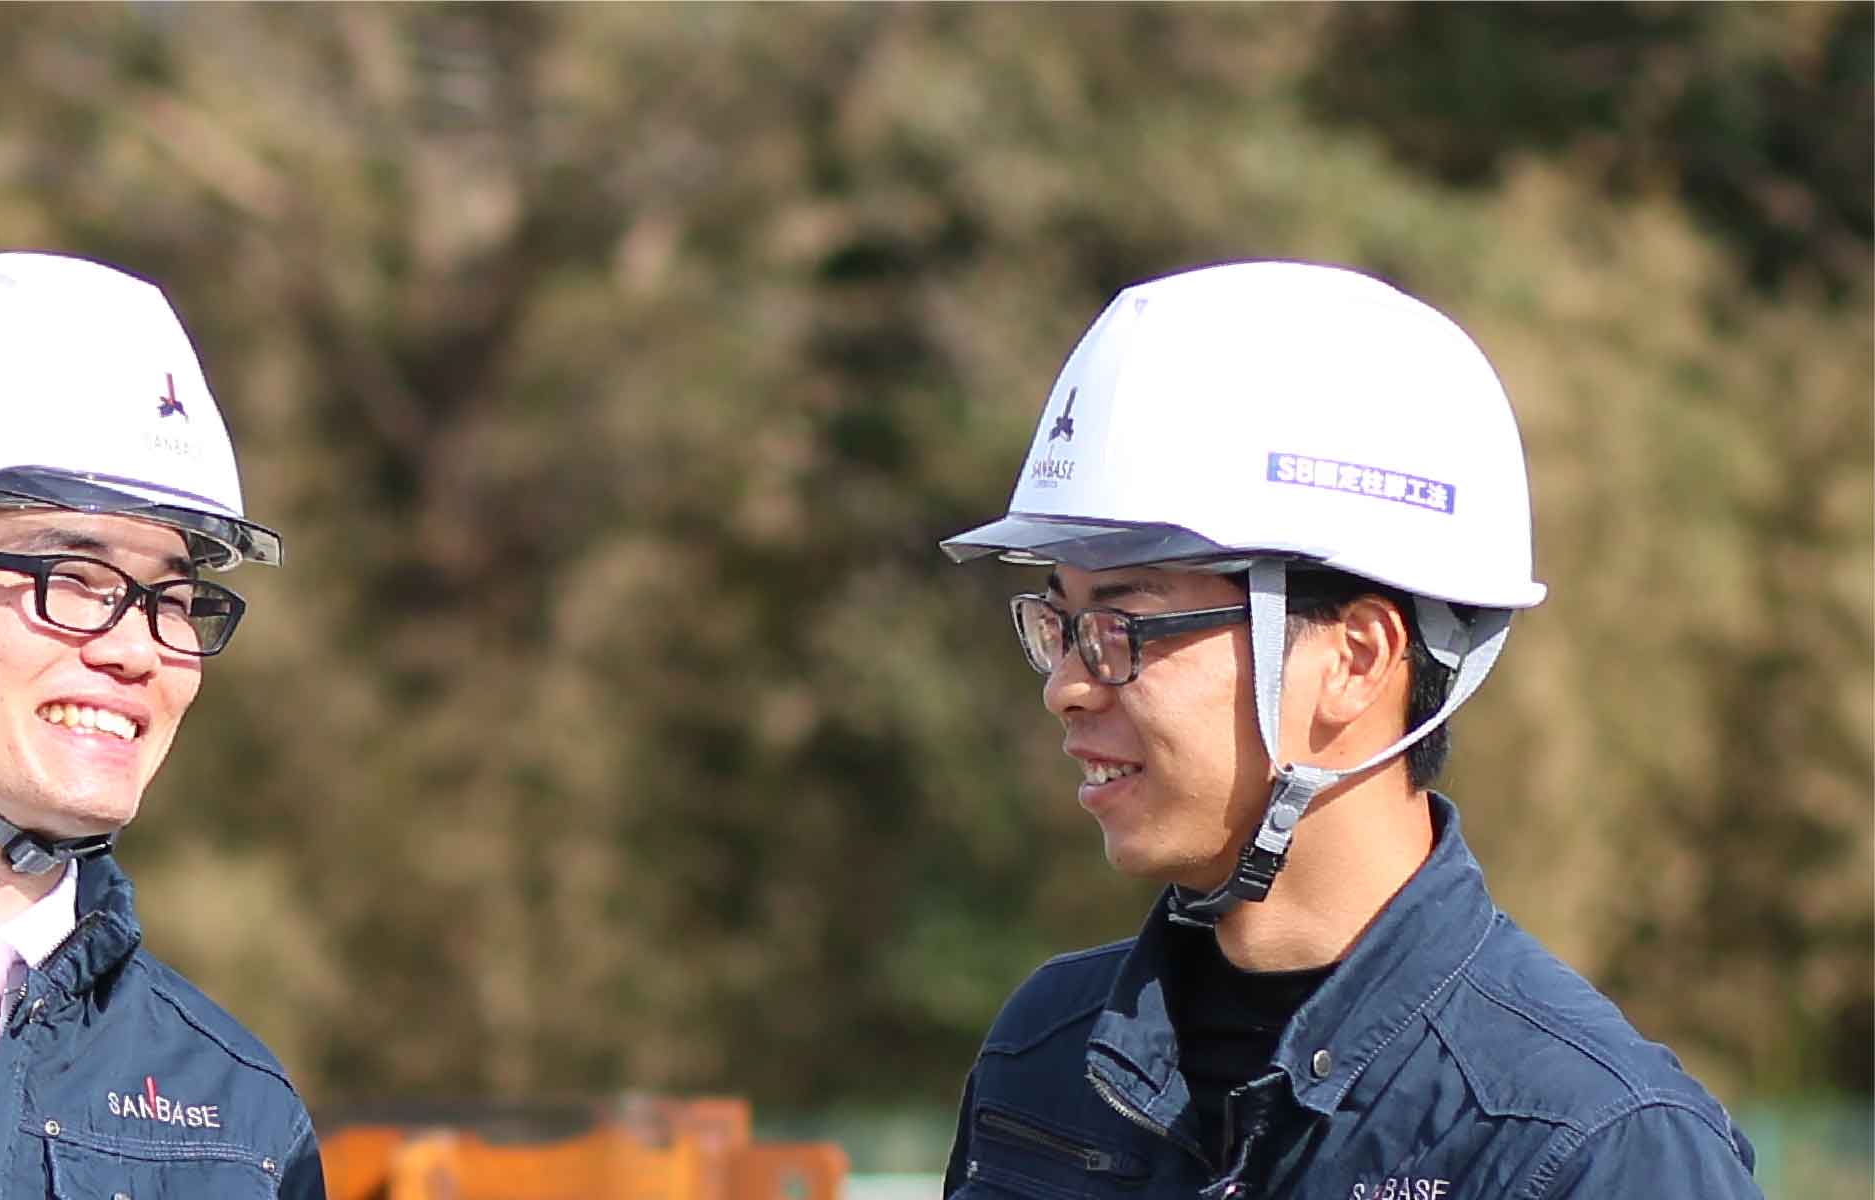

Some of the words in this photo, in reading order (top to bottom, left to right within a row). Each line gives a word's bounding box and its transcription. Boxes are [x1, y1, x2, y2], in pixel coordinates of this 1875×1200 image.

[1275, 455, 1448, 512] SB定柱工法
[107, 1076, 221, 1129] SANBASE
